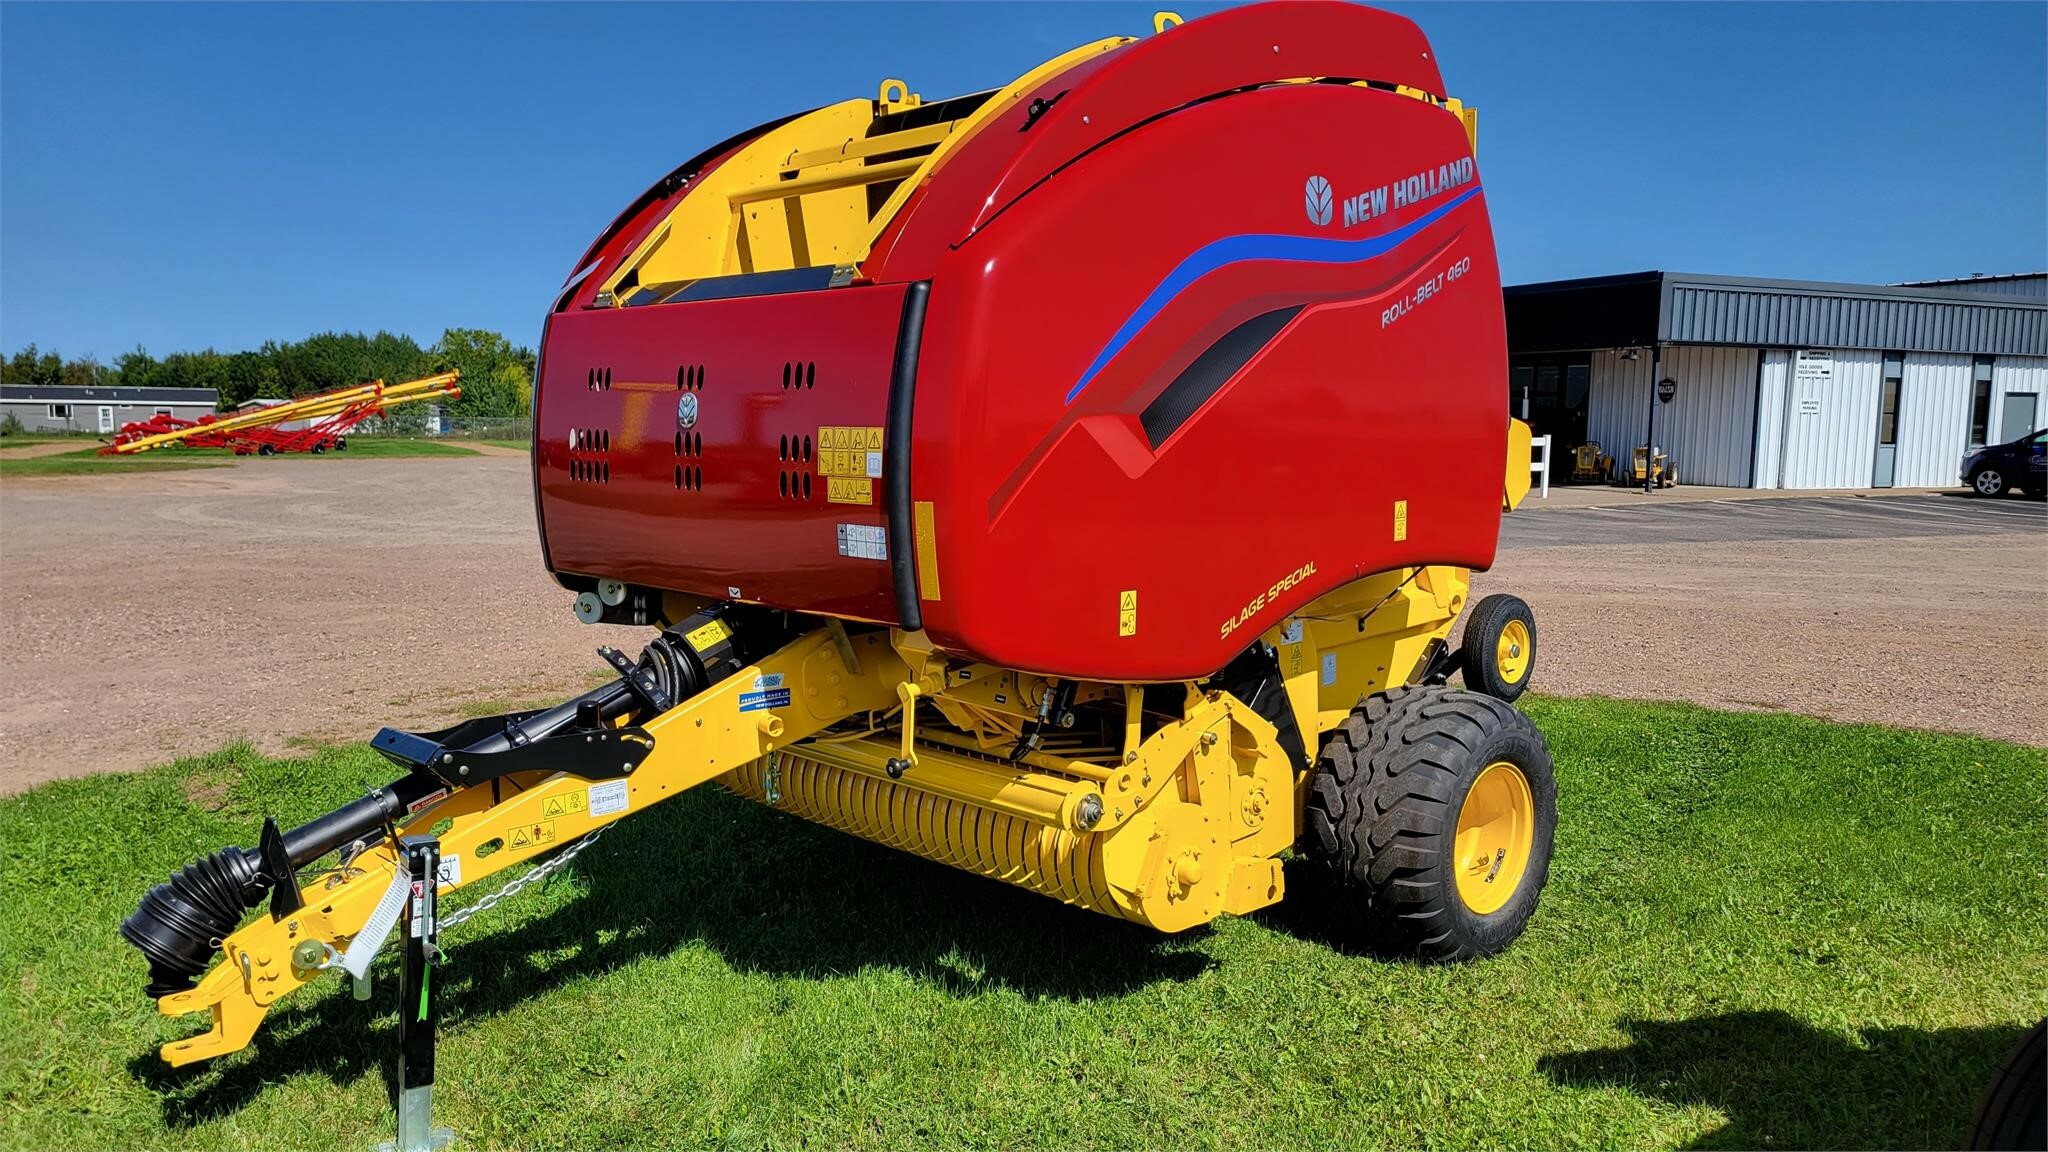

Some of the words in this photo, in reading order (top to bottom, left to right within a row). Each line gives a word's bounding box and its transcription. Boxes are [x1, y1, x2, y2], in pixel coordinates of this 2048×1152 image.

[1343, 185, 1388, 229] NEW
[1393, 156, 1473, 209] HOLLAND
[1381, 273, 1444, 329] ROLL-BELT
[1447, 256, 1471, 283] 460
[1221, 593, 1266, 640] SILAGE
[1267, 560, 1317, 603] SPECIAL
